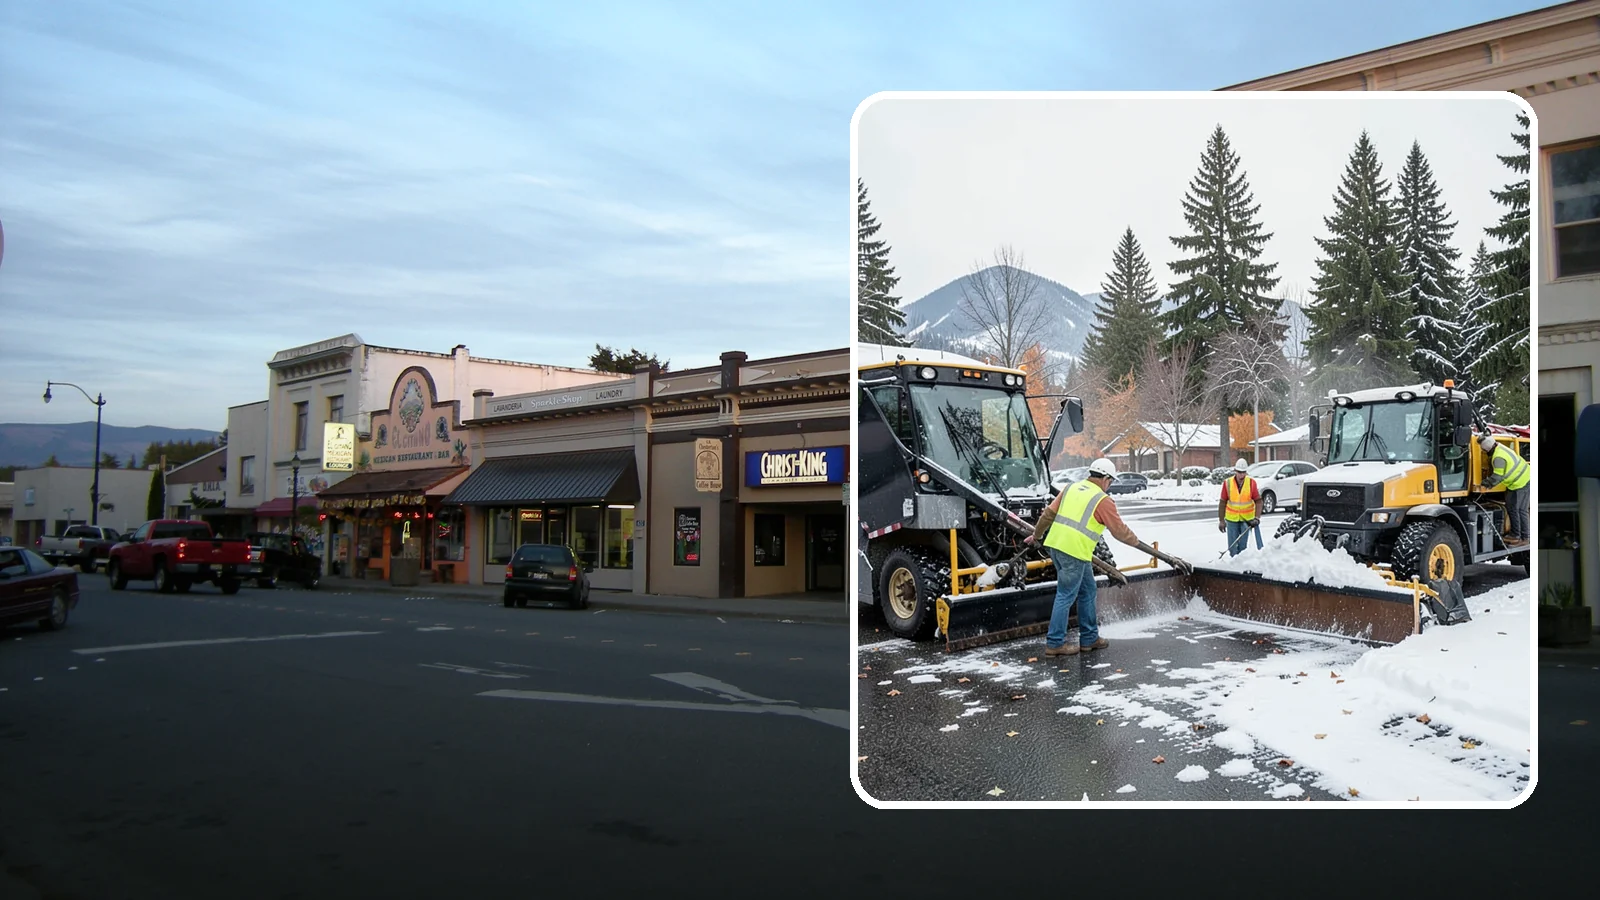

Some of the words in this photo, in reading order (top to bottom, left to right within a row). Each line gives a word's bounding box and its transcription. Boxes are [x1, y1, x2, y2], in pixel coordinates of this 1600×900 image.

[531, 397, 561, 408] Sparkle
[562, 394, 582, 405] Shop
[595, 388, 623, 400] LAUNDRY
[493, 402, 522, 412] LAVANDERIA
[373, 455, 396, 464] MEXICAN
[397, 451, 433, 462] RESTAURANT
[438, 450, 450, 459] BAR
[761, 452, 797, 477] CHRIST
[799, 450, 827, 476] KING
